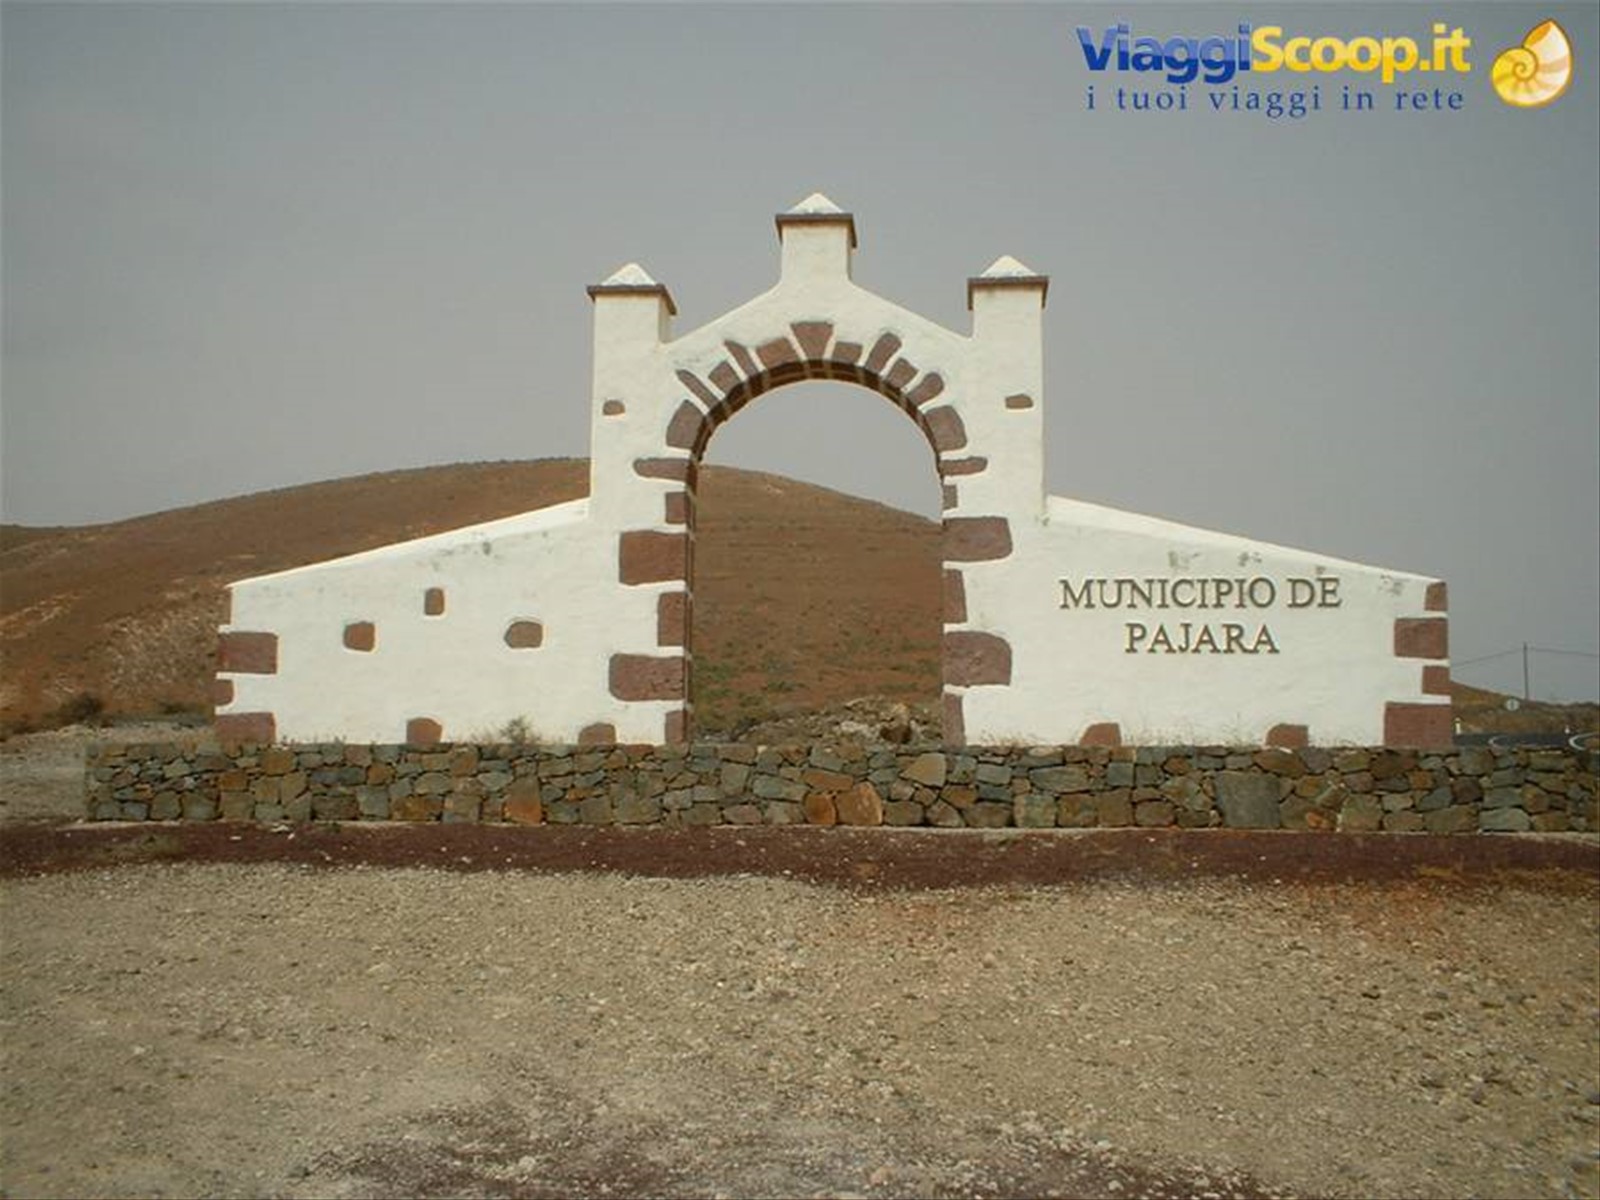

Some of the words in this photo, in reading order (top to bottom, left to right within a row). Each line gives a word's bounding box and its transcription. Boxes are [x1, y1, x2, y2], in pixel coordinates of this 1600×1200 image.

[1059, 577, 1277, 609] MUNICIPIO
[1286, 577, 1343, 609] DE
[1124, 622, 1280, 654] PAJARA
